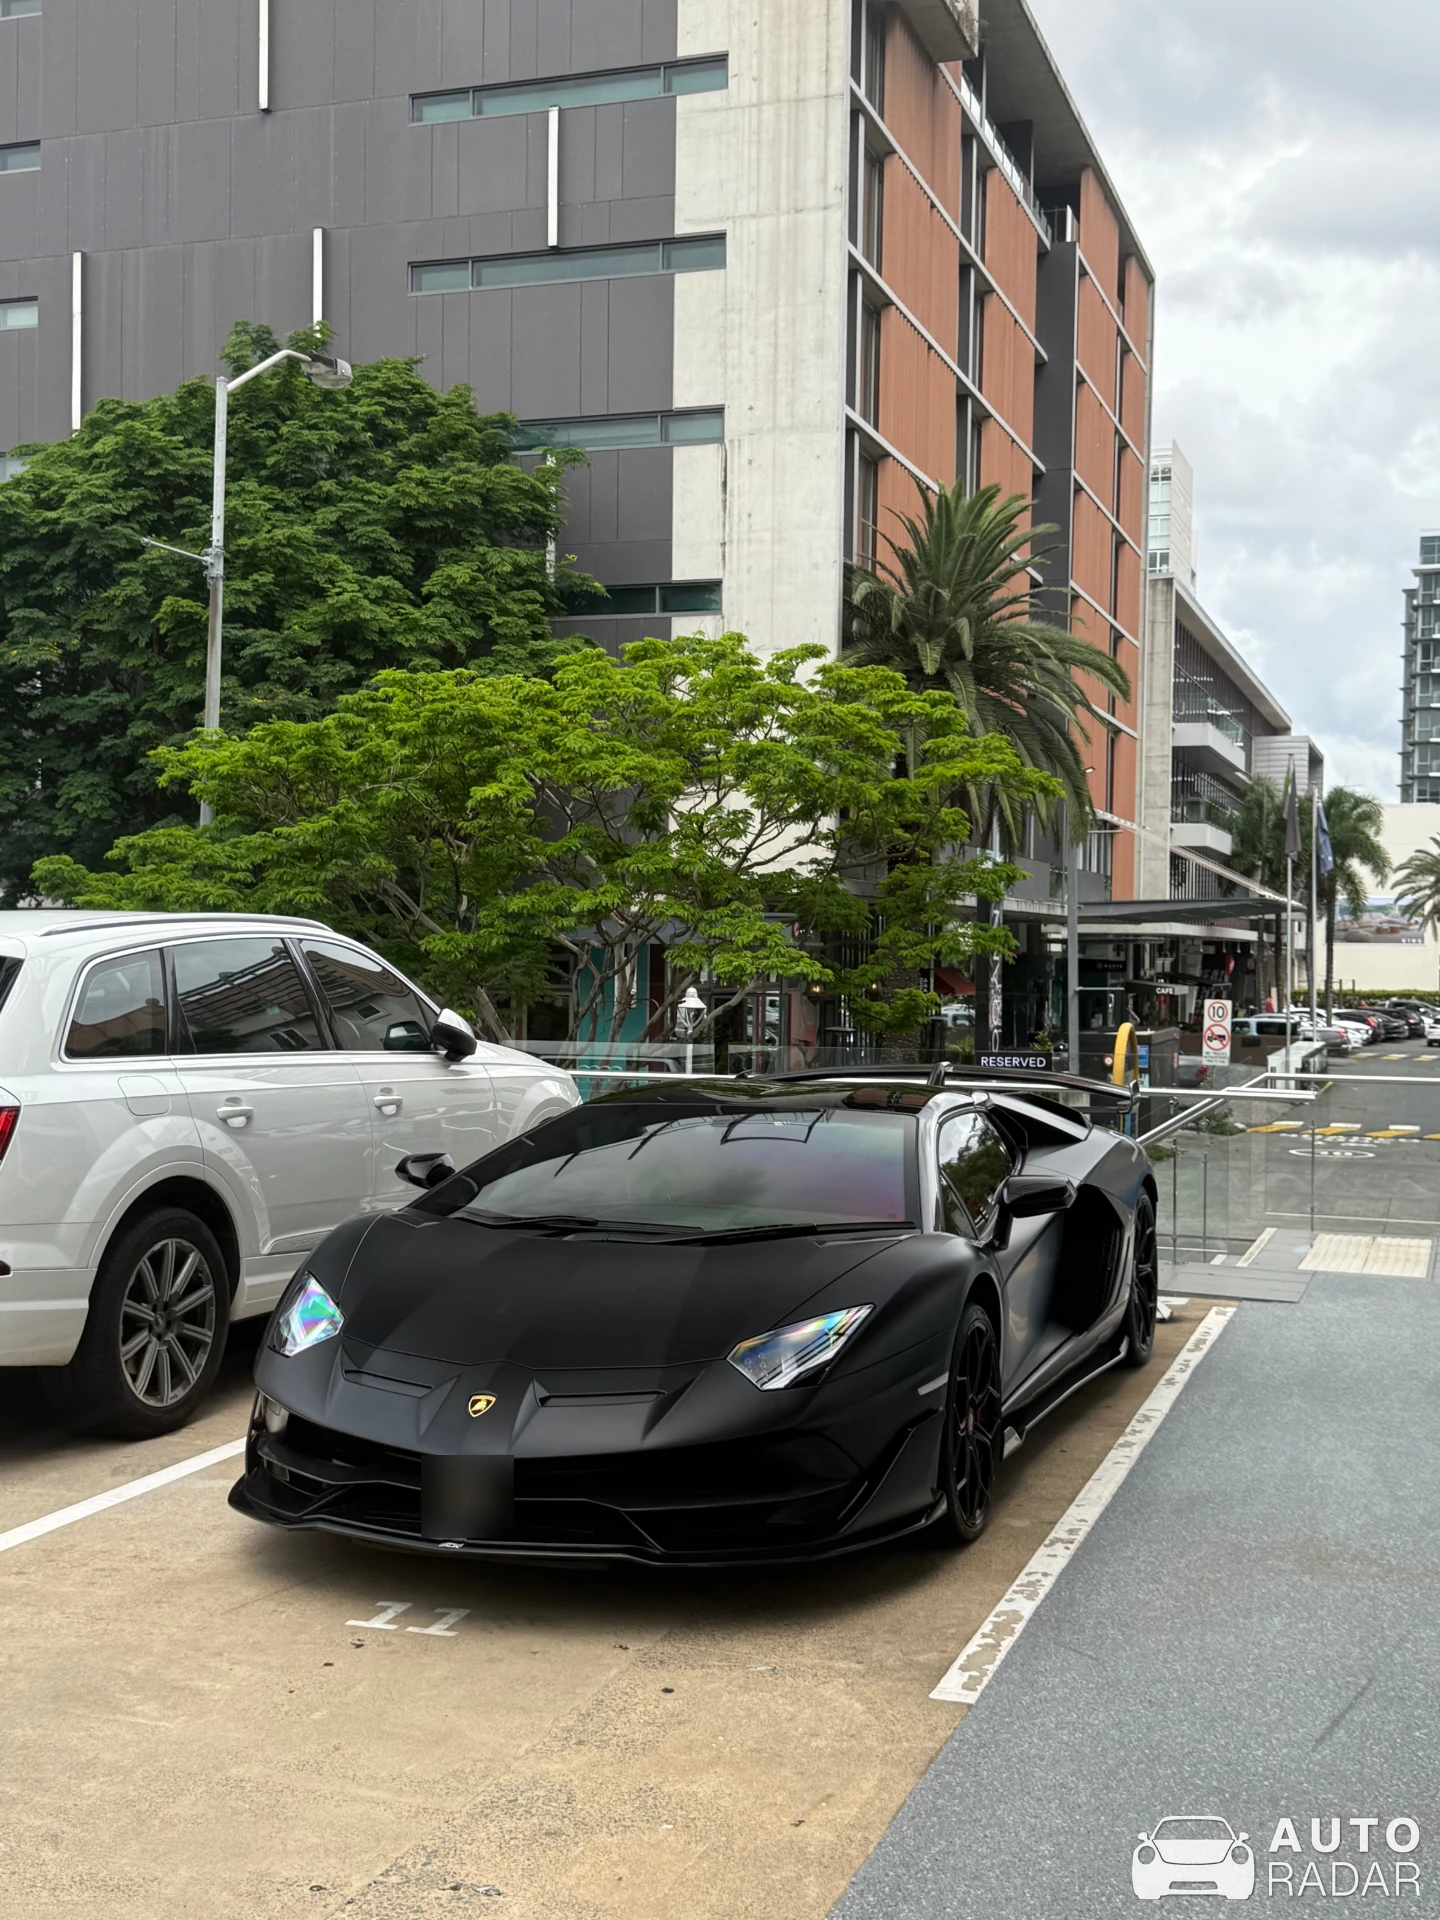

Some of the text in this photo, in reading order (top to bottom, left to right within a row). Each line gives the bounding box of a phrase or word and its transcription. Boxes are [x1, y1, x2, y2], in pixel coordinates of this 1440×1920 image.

[1212, 1006, 1225, 1019] 10
[980, 1056, 1047, 1068] RESERVED
[344, 1601, 472, 1637] 11
